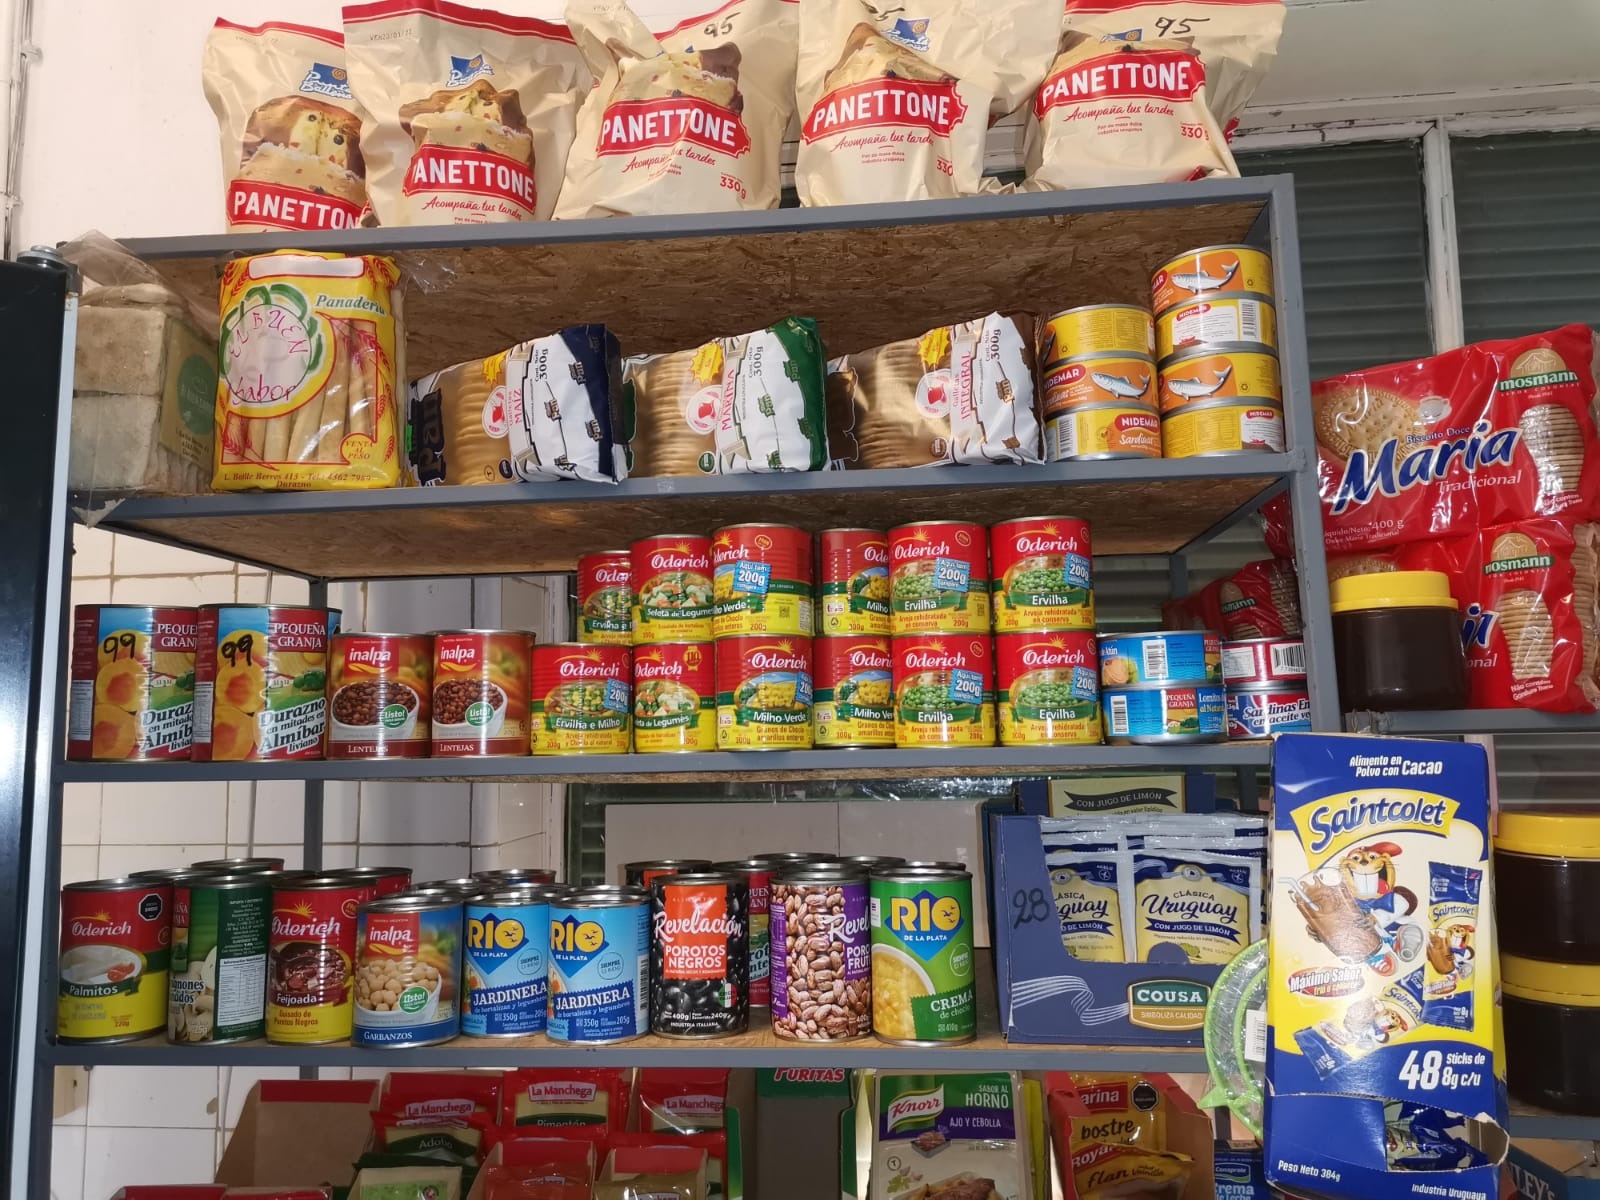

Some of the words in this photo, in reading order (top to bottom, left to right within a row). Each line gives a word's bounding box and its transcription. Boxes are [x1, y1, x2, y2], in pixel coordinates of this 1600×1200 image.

[704, 11, 742, 37] 95
[1155, 16, 1211, 38] 95
[1042, 61, 1192, 107] PANETTONE
[812, 89, 950, 133] PANETTONE
[1063, 104, 1126, 121] Acompaña
[1126, 103, 1142, 114] tus
[1144, 103, 1174, 116] tardes
[600, 107, 737, 147] PANETTONE
[830, 134, 888, 153] Acompaña
[889, 131, 904, 142] tus
[685, 147, 716, 166] tardes
[990, 329, 1001, 360] 300g
[538, 348, 549, 380] 300g
[753, 346, 764, 377] 300g
[960, 352, 971, 421] INTEGRAL
[1500, 371, 1578, 391] mosmann
[1406, 431, 1444, 445] Biscoito
[1446, 426, 1470, 437] Doce
[1330, 420, 1522, 515] Maria
[1436, 470, 1522, 494] Tradicional
[894, 541, 950, 560] Oderich
[1016, 536, 1078, 553] Oderich
[651, 554, 709, 569] Oderich
[738, 570, 765, 586] 200g
[940, 567, 966, 585] 200g
[1069, 563, 1090, 580] 200g
[722, 601, 746, 612] Verde
[866, 600, 889, 614] Milho
[904, 599, 937, 611] Ervilha
[1032, 594, 1068, 606] Ervilha
[647, 607, 670, 617] Seleta
[1024, 610, 1042, 618] Arveja
[1043, 608, 1077, 618] rehidratada
[1042, 616, 1070, 624] conserva
[274, 622, 325, 635] PEQUEÑA
[592, 619, 620, 630] Ervilha
[103, 633, 136, 662] 99
[221, 634, 254, 667] 99
[277, 636, 322, 648] GRANJA
[349, 647, 392, 664] inalpa
[440, 644, 475, 663] inalpa
[751, 652, 807, 669] Oderich
[905, 652, 966, 669] Oderich
[1022, 649, 1084, 666] Oderich
[560, 660, 619, 677] Oderich
[635, 661, 682, 677] Oderich
[955, 679, 980, 698] 200g
[1076, 676, 1096, 694] 200g
[261, 699, 325, 725] Durazno
[384, 709, 405, 719] Listo!
[753, 710, 781, 723] Milho
[784, 711, 806, 722] Verde
[854, 707, 880, 719] Milho
[918, 711, 954, 722] Ervilha
[1039, 709, 1076, 720] Ervilha
[1269, 713, 1298, 723] aceite
[267, 724, 278, 734] en
[280, 713, 315, 731] mitades
[555, 718, 587, 730] Ervilha
[589, 721, 595, 729] e
[597, 718, 621, 729] Milho
[653, 715, 690, 728] Legumes
[259, 722, 324, 752] Almíbar
[289, 737, 318, 753] liviano
[439, 743, 474, 752] LENTEJAS
[1349, 755, 1389, 767] Alimento
[1390, 756, 1402, 766] en
[1355, 766, 1381, 778] Polvo
[1382, 767, 1399, 777] con
[1401, 760, 1443, 776] Cacao
[1076, 799, 1095, 808] CON
[1096, 797, 1119, 808] JUGO
[1120, 794, 1131, 802] DE
[1133, 791, 1162, 801] LIMÓN
[1310, 796, 1447, 853] Saintcolet
[1173, 890, 1215, 901] CLÁSICA
[890, 896, 961, 932] RIO
[1013, 887, 1049, 930] 28
[1141, 893, 1238, 924] Uruguay
[1432, 904, 1475, 923] Saintcolet
[72, 921, 132, 936] Oderich
[272, 917, 341, 936] Oderich
[467, 918, 525, 949] RIO
[653, 910, 743, 943] Revelación
[1079, 922, 1103, 930] LIMÓN
[1154, 922, 1171, 931] CON
[1204, 924, 1231, 936] LIMÓN
[369, 926, 412, 945] inalpa
[551, 920, 605, 953] RIO
[926, 934, 948, 942] PLATA
[665, 945, 726, 957] POROTOS
[668, 956, 722, 969] NEGROS
[69, 984, 118, 996] Palmitos
[1290, 972, 1330, 992] Máximo
[277, 994, 317, 1005] Feijoada
[473, 981, 547, 1006] JARDINERA
[556, 987, 631, 1011] JARDINERA
[930, 990, 973, 1013] CREMA
[1137, 988, 1203, 1003] COUSA
[303, 1010, 311, 1018] de
[480, 1004, 511, 1013] hortalizas
[502, 1012, 518, 1022] 350g
[562, 1009, 592, 1018] hortalizas
[598, 1001, 631, 1013] legumbres
[672, 1012, 689, 1021] 400g
[939, 1011, 950, 1020] de
[1140, 1011, 1174, 1019] SIMBOLIZA
[1175, 1011, 1203, 1019] CALIDAD
[583, 1018, 599, 1028] 350g
[616, 1016, 630, 1026] 205g
[364, 1031, 413, 1041] GARBANZOS
[1446, 1052, 1473, 1065] Sticks
[1474, 1053, 1485, 1065] de
[1399, 1050, 1443, 1091] 48
[1442, 1067, 1458, 1089] 8g
[1460, 1072, 1481, 1086] c/u
[531, 1086, 542, 1096] La
[544, 1084, 593, 1098] Manchega
[978, 1085, 999, 1093] SABOR
[999, 1085, 1008, 1093] AL
[408, 1105, 419, 1115] La
[420, 1101, 472, 1114] Manchega
[667, 1100, 677, 1109] La
[679, 1100, 724, 1112] Manchega
[891, 1097, 942, 1118] Knorr
[965, 1093, 1009, 1109] HORNO
[950, 1117, 963, 1127] AJO
[964, 1117, 970, 1126] Y
[972, 1117, 1001, 1128] CEBOLLA
[1088, 1170, 1129, 1188] flan
[1278, 1160, 1298, 1174] Peso
[1299, 1162, 1319, 1177] Neto
[1320, 1167, 1341, 1182] 384g
[1412, 1183, 1447, 1196] Industria
